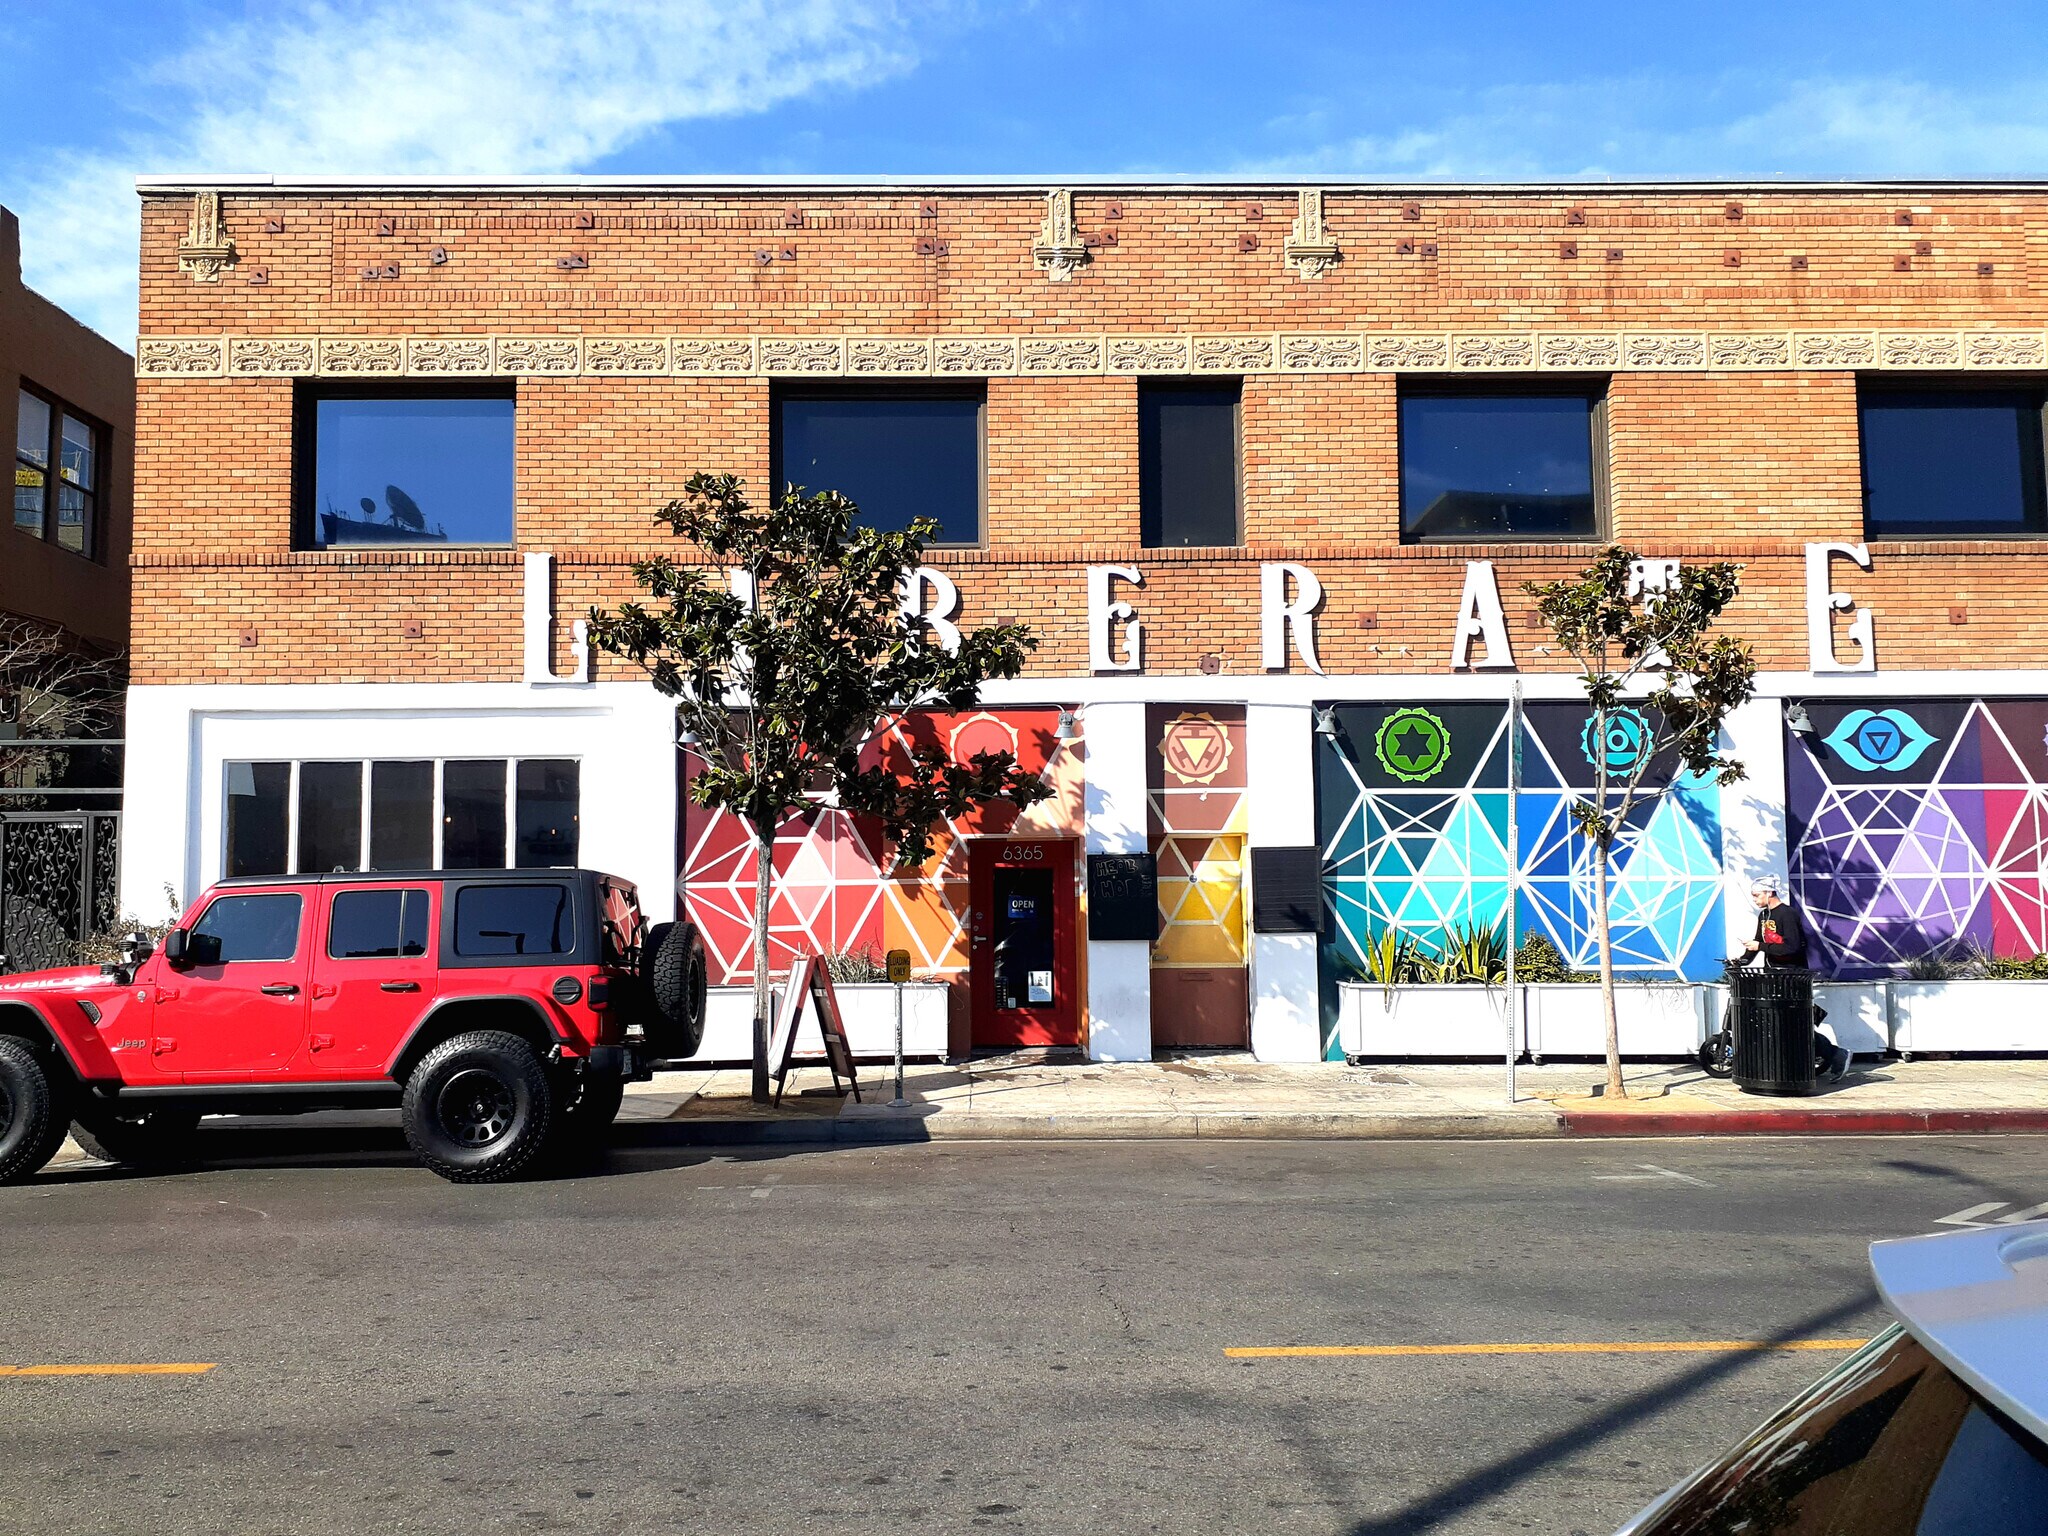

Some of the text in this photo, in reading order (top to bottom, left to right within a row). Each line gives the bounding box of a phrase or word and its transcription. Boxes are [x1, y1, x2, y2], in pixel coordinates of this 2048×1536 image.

[522, 542, 1877, 684] LIBERATE
[1002, 845, 1044, 861] 6365
[1011, 899, 1035, 909] OPEN
[0, 973, 115, 991] UBICON
[117, 1037, 147, 1049] Jeep
